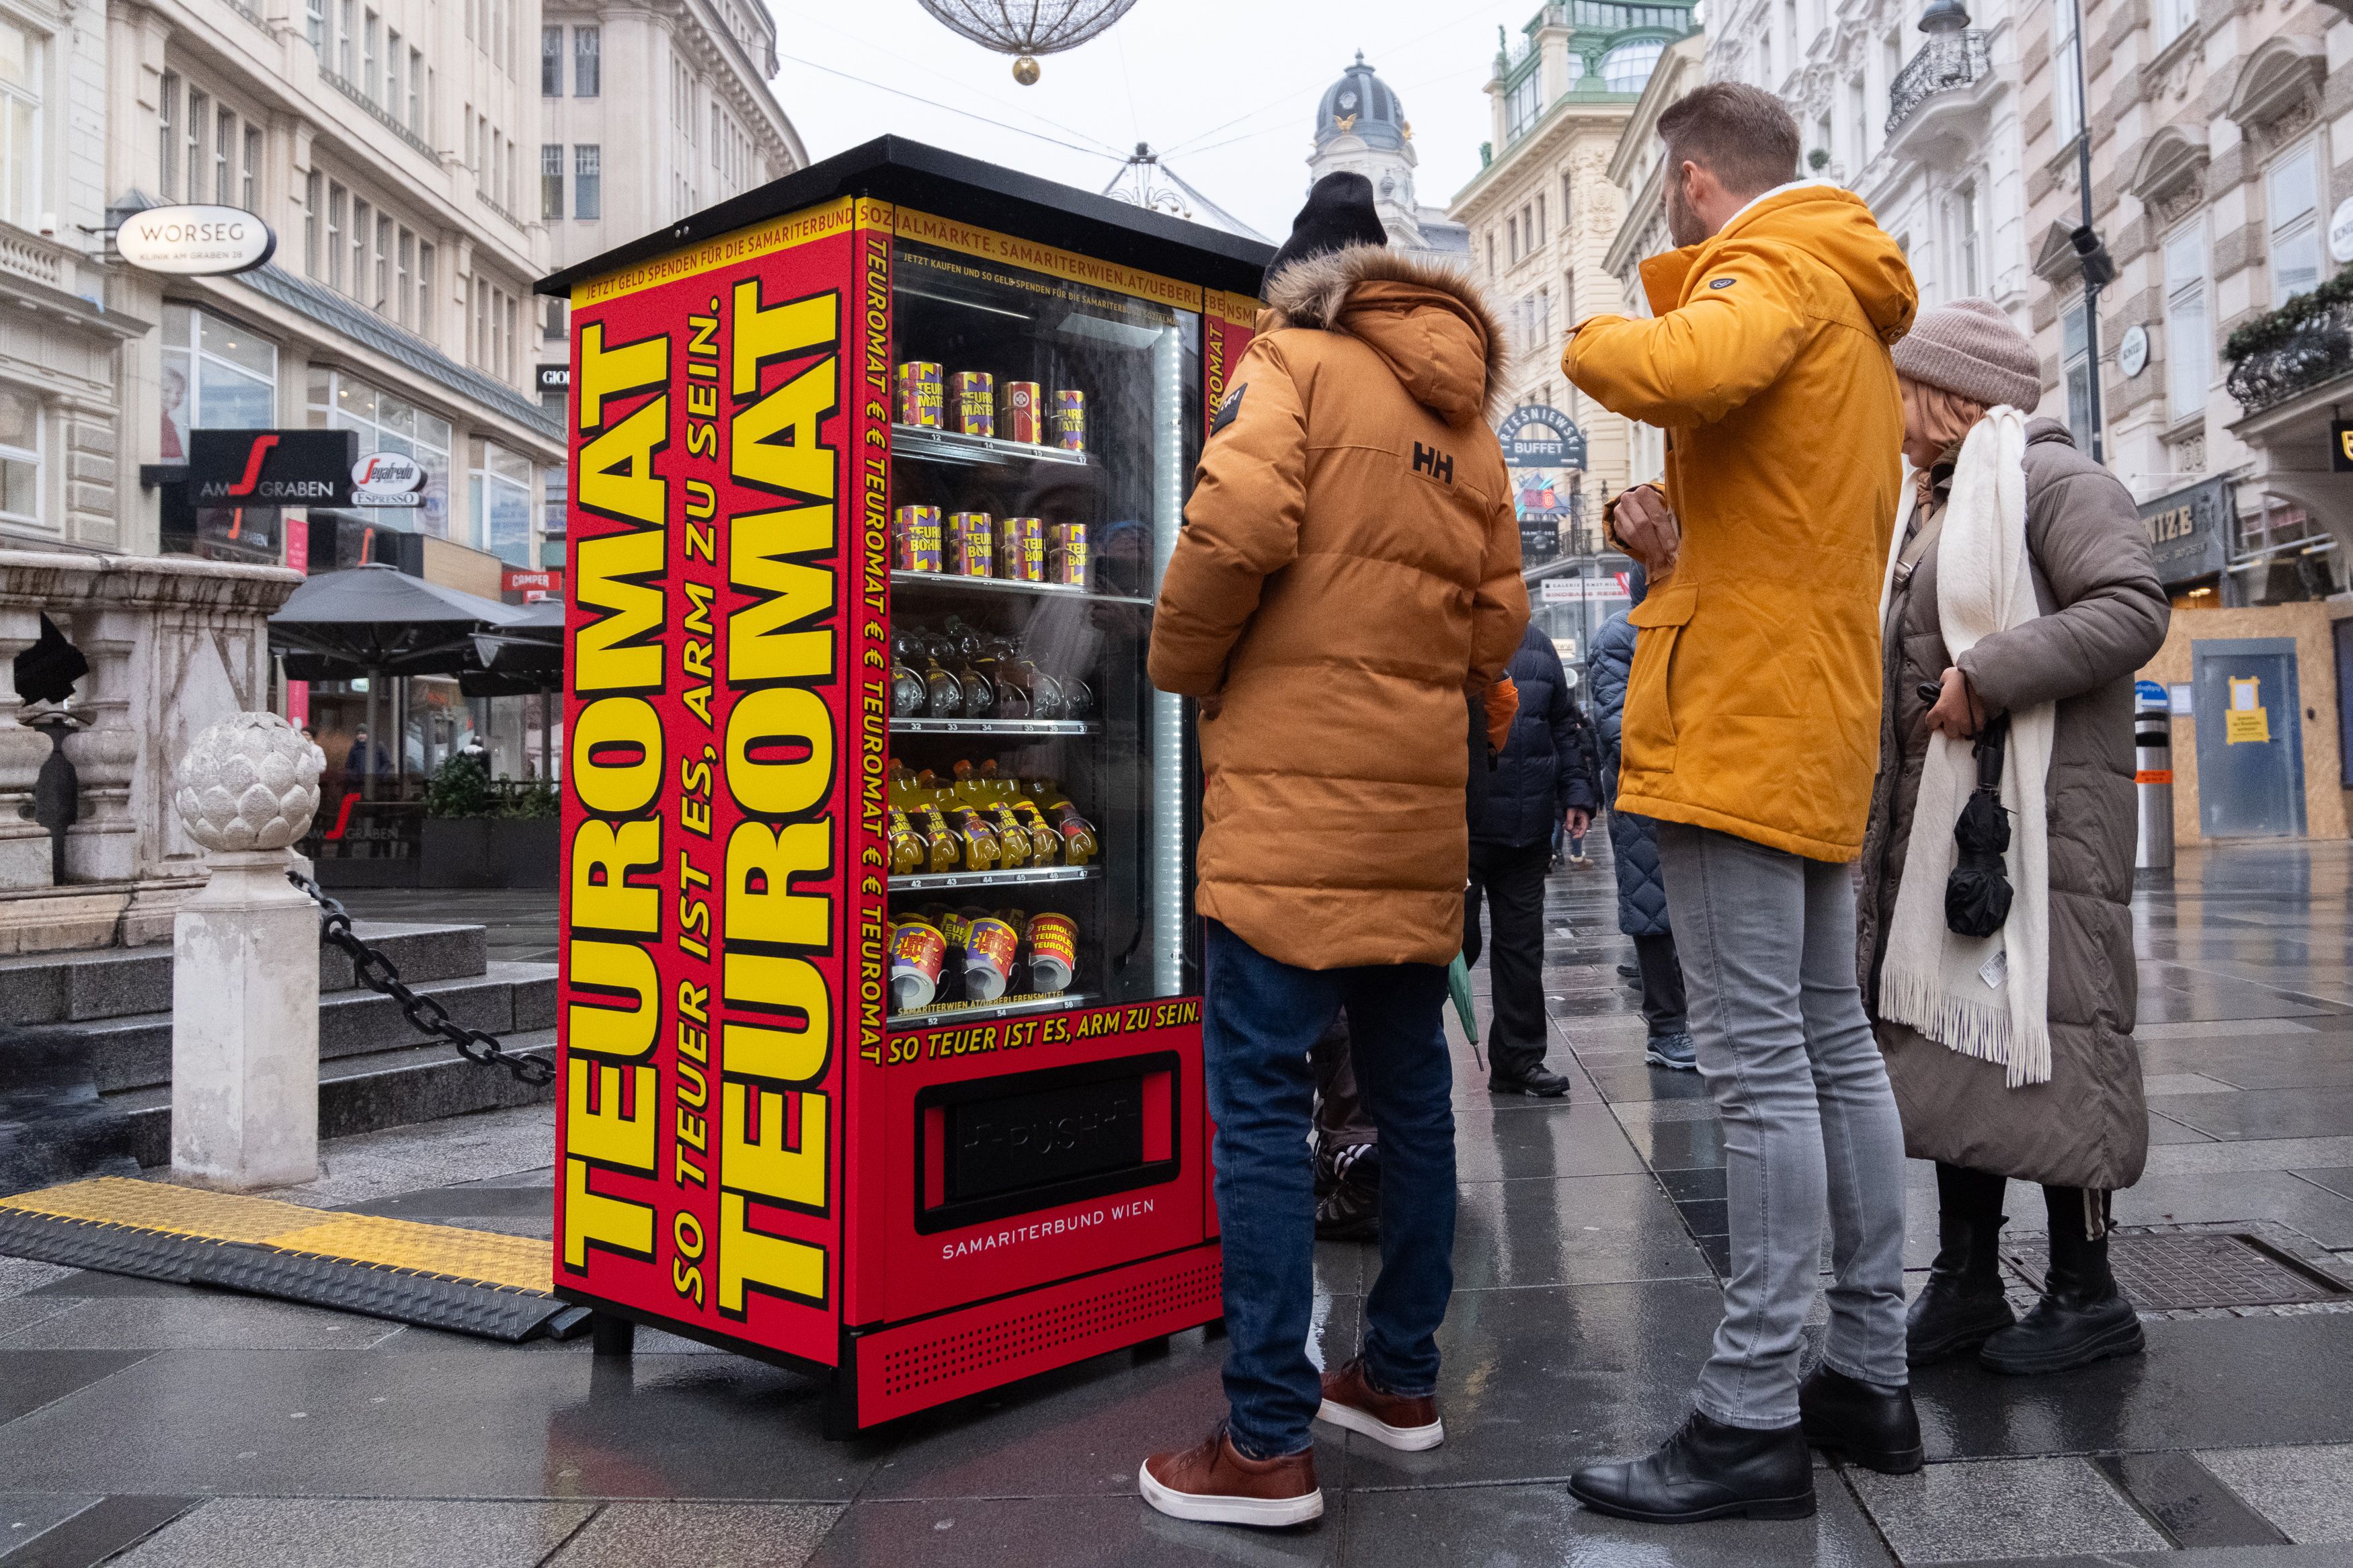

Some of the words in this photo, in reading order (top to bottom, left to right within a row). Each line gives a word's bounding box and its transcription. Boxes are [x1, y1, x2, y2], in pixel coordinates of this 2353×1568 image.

[139, 252, 168, 261] KLINIK
[190, 251, 229, 260] GRABEN
[140, 223, 244, 242] WORSEG
[586, 278, 615, 300] JETZT
[619, 272, 645, 291] GELD
[648, 253, 697, 282] SPENDEN
[701, 245, 722, 267] FÜR
[726, 238, 744, 257] DIE
[748, 207, 853, 251] SAMARITERBUND
[860, 205, 995, 253] SOZIALMÄRKTE.
[866, 238, 887, 394] TEUROMAT
[904, 253, 928, 265] JETZT
[931, 259, 961, 274] KAUFEN
[963, 266, 980, 278] UND
[982, 271, 992, 281] SO
[1016, 280, 1050, 296] SPENDEN
[1052, 287, 1066, 299] FÜR
[1068, 292, 1080, 302] DIE
[686, 296, 721, 458] SEIN.
[201, 481, 229, 497] AM
[259, 481, 334, 497] GRABEN
[1412, 441, 1453, 485] HH
[1515, 442, 1563, 454] BUFFET
[356, 493, 413, 503] ESPRESSO
[686, 479, 718, 565] ZU
[865, 458, 885, 614] TEUROMAT
[512, 574, 549, 588] CAMPER
[683, 583, 716, 728] ARM
[565, 321, 670, 1272] TEUROMAT
[681, 742, 717, 838] ES,
[719, 277, 841, 1316] TEUROMAT
[863, 680, 883, 837] TEUROMAT
[677, 851, 712, 963] IST
[912, 880, 922, 888] 42
[861, 906, 881, 1065] TEUROMAT
[928, 1018, 938, 1026] 52
[887, 1037, 920, 1063] SO
[928, 1027, 996, 1058] TEUER
[1003, 1021, 1035, 1047] IST
[1042, 1017, 1072, 1042] ES,
[1076, 1012, 1122, 1038] ARM
[1125, 1007, 1152, 1030] ZU
[1155, 1001, 1199, 1028] SEIN.
[675, 979, 710, 1188] TEUER
[673, 1210, 705, 1310] SO
[943, 1210, 1104, 1260] SAMARITERBUND
[1111, 1199, 1154, 1220] WIEN
